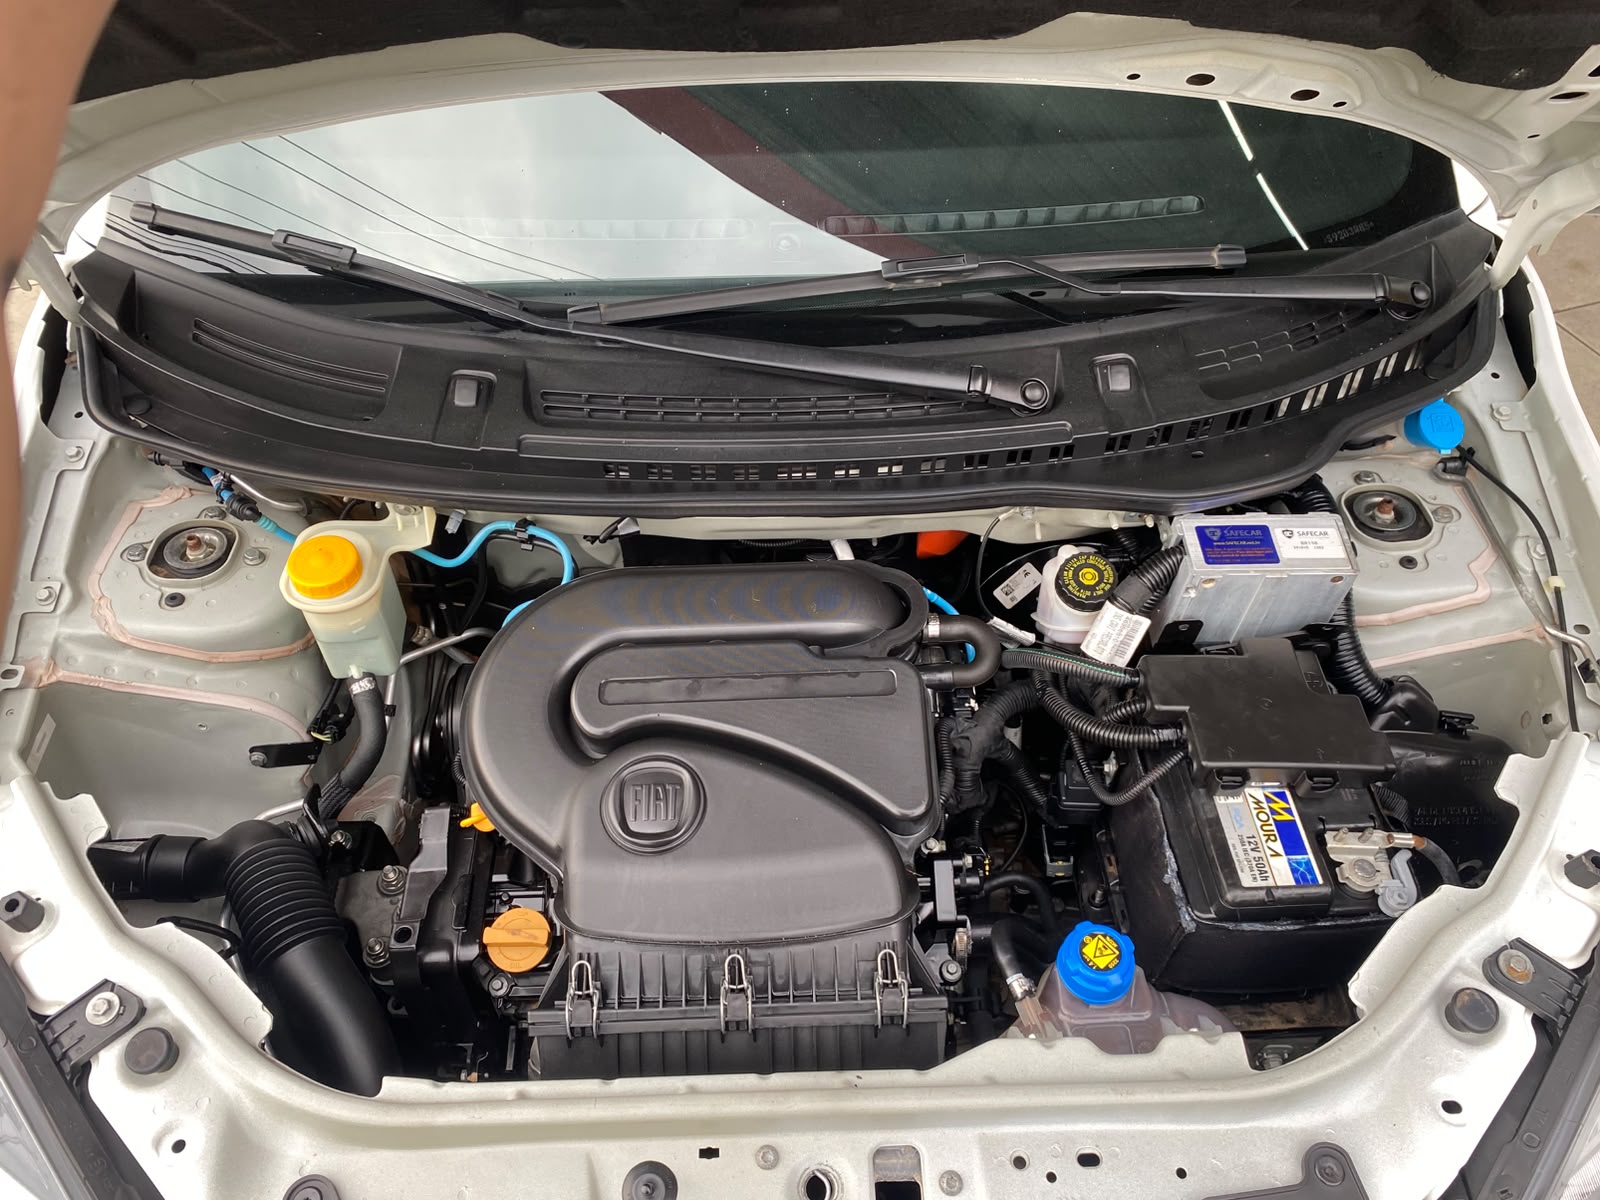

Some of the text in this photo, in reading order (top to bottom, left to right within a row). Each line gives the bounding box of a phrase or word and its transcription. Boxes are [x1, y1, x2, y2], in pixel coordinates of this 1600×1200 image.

[1223, 529, 1263, 537] SAFECAR
[630, 783, 681, 822] FIAT
[1248, 792, 1284, 858] MOURA
[1246, 834, 1270, 882] 12V 50Ah
